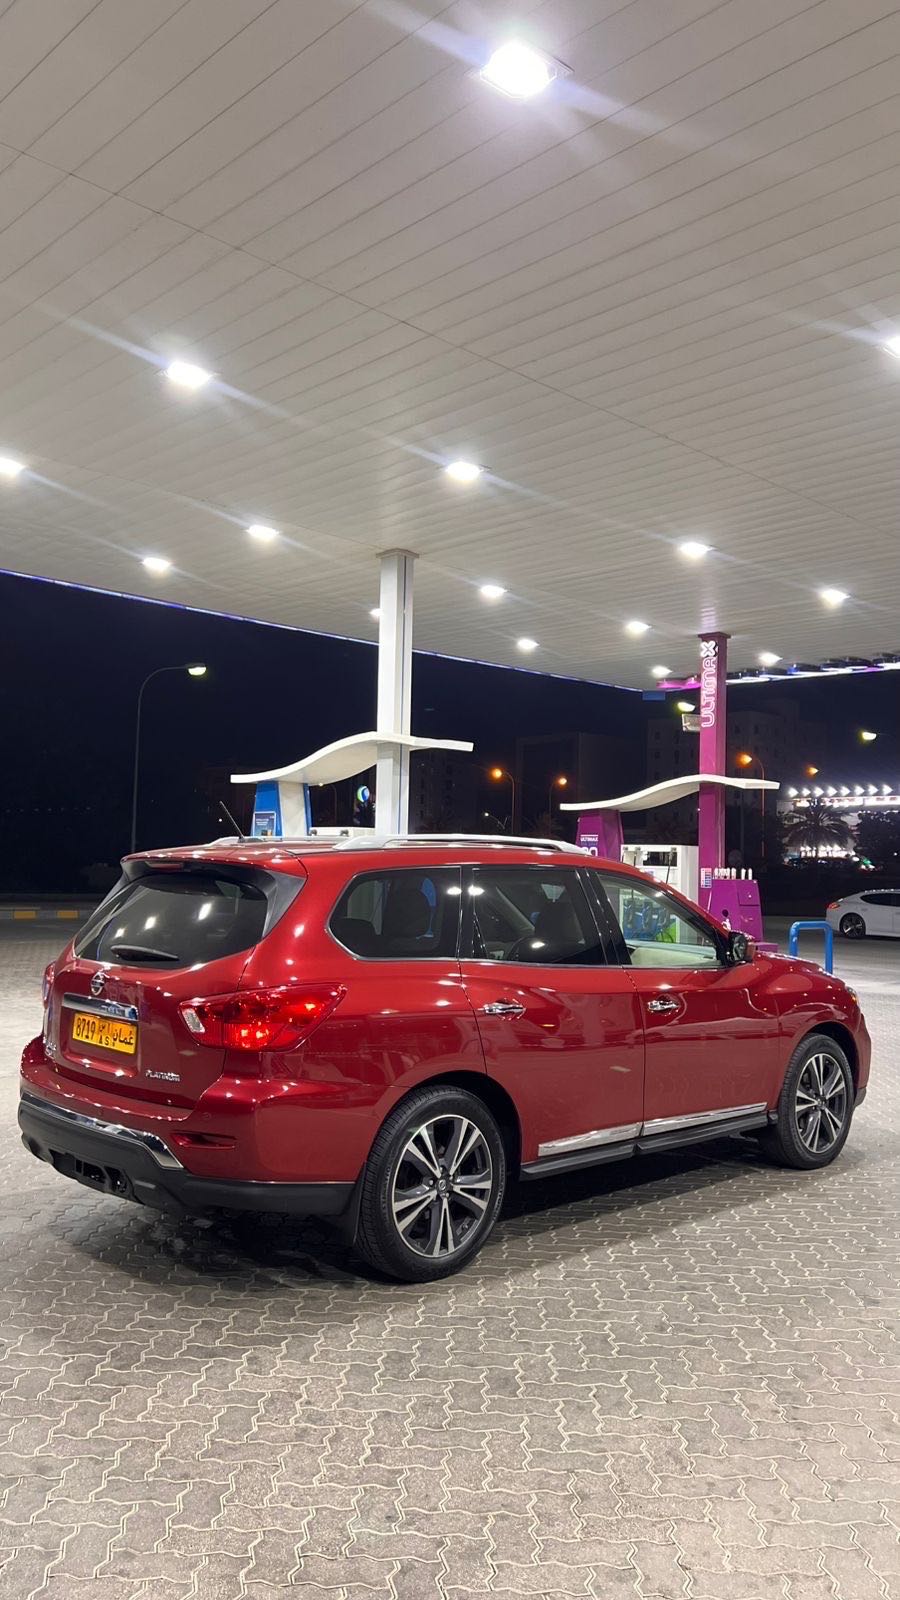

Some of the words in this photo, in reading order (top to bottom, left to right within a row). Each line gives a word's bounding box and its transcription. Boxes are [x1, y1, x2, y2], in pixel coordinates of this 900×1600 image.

[701, 641, 717, 728] ULTIMAX
[76, 1017, 96, 1040] 8719
[145, 1069, 181, 1082] PLATINUM
